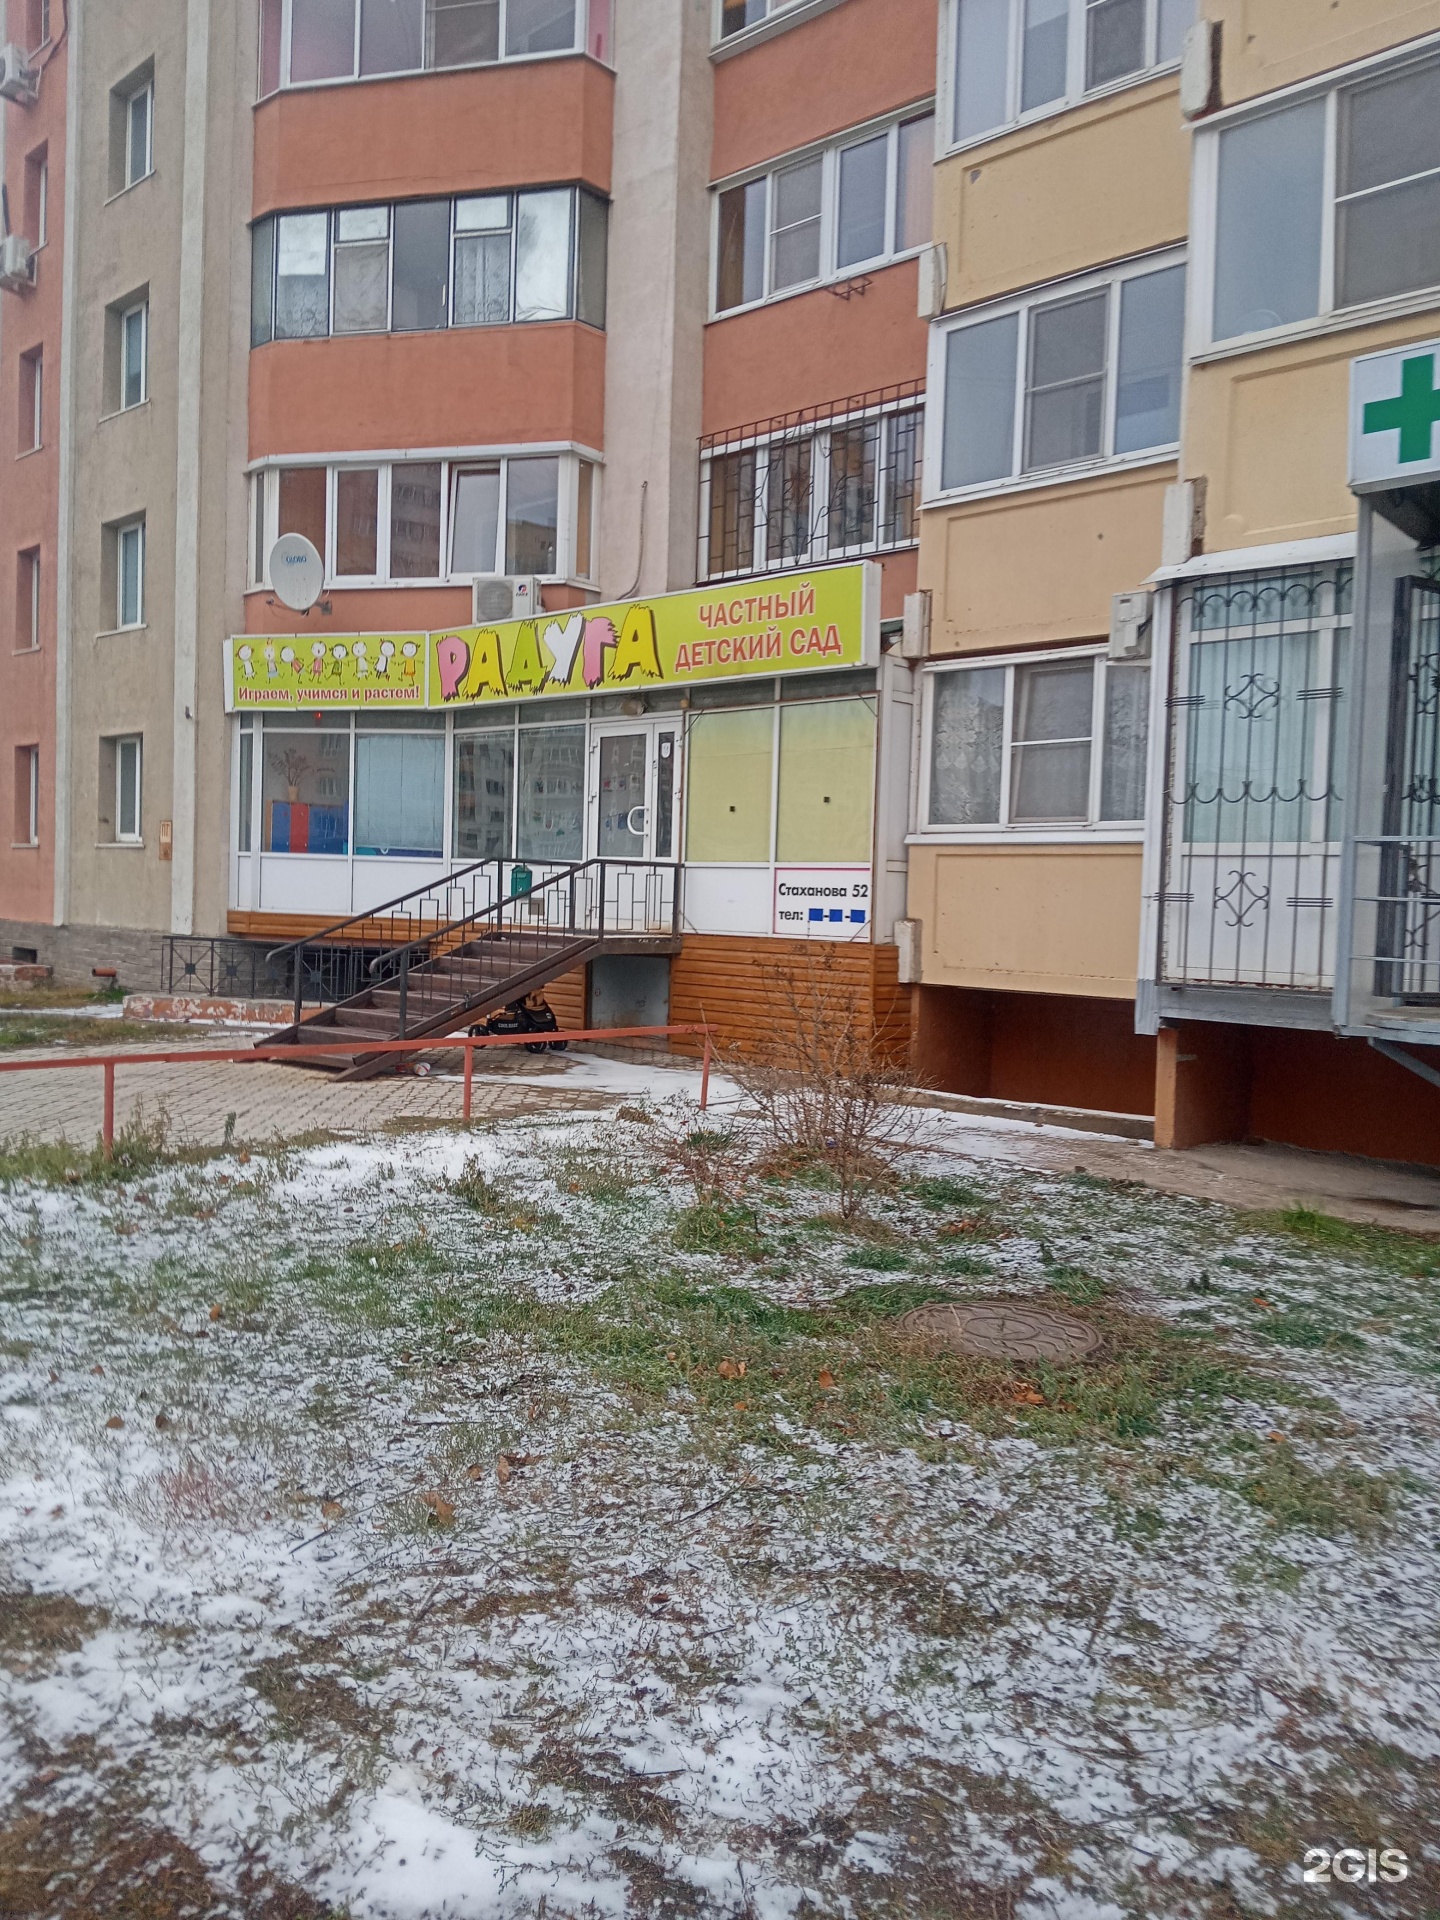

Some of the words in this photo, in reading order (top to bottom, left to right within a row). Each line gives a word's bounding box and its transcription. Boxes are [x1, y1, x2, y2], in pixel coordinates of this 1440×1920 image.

[699, 581, 815, 628] ЧАСТНЫЙ
[436, 603, 664, 702] РАДУГА
[674, 625, 782, 673] ДЕТСКИЙ
[789, 624, 843, 657] САД
[238, 686, 293, 702] Играем,
[297, 688, 348, 702] учимся
[351, 688, 360, 699] и
[364, 685, 420, 702] растем!
[778, 882, 847, 897] Стаханова
[852, 884, 869, 898] 52
[778, 910, 804, 921] тел:
